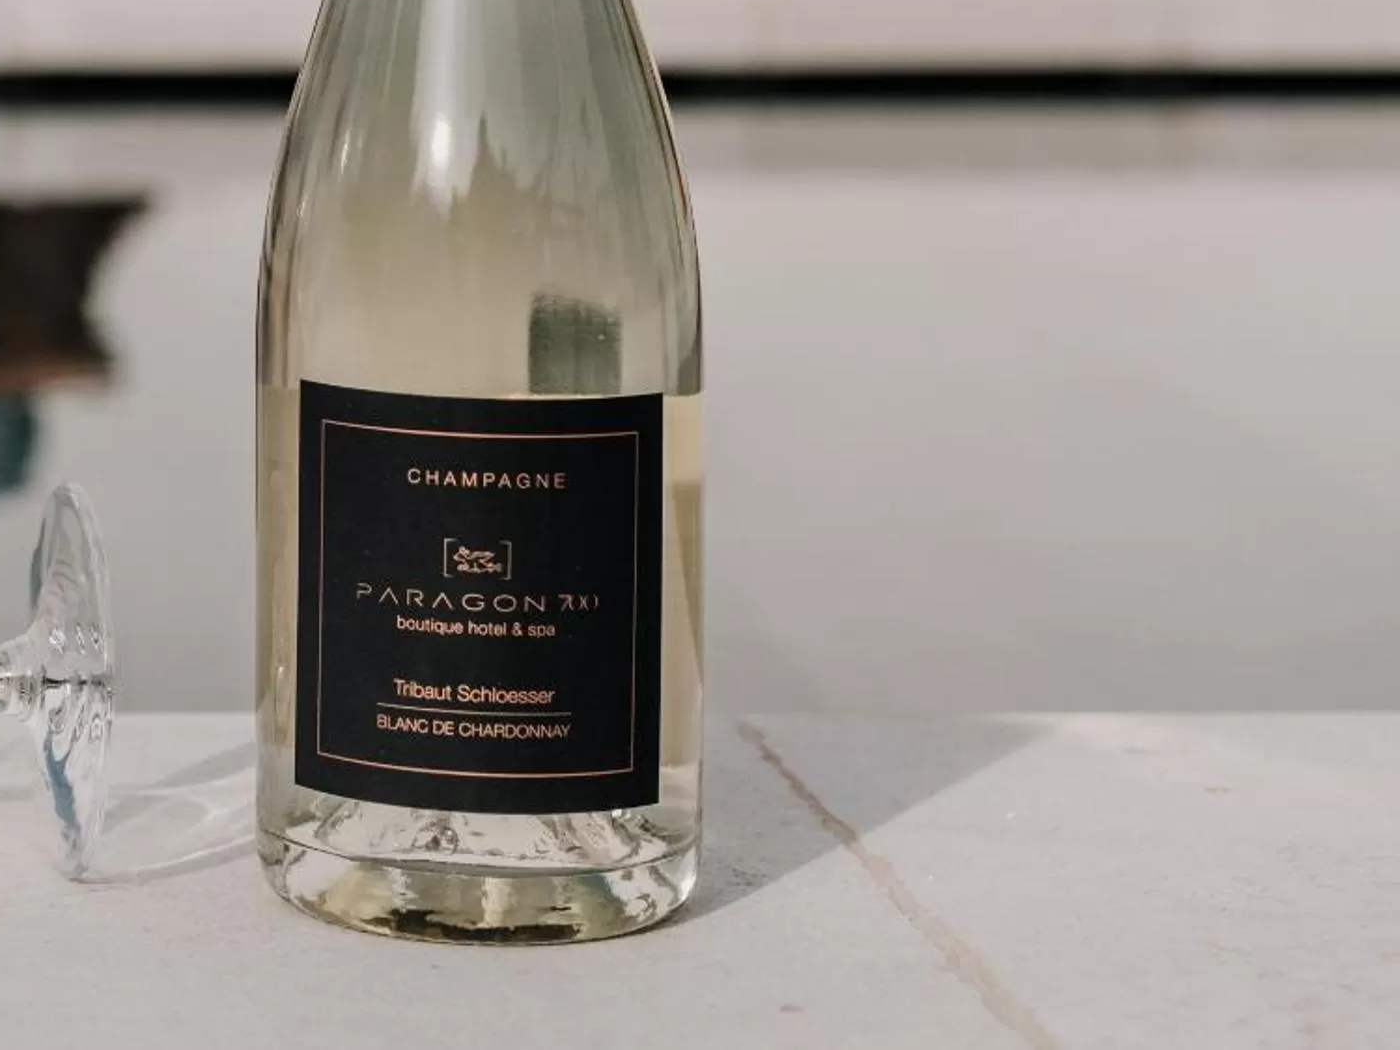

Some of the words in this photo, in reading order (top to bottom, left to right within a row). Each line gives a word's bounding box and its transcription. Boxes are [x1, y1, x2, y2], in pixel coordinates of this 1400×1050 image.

[406, 467, 567, 490] CHAMPAGNE
[355, 582, 546, 613] PARAGON
[396, 614, 464, 637] boutique
[467, 619, 507, 637] hotel
[511, 621, 523, 637] &
[526, 624, 556, 639] spa
[393, 678, 452, 701] Tribaut
[456, 684, 556, 705] Schloesser
[376, 713, 429, 734] BLANC
[432, 719, 455, 736] DE
[458, 721, 572, 740] CHARDONNAY
